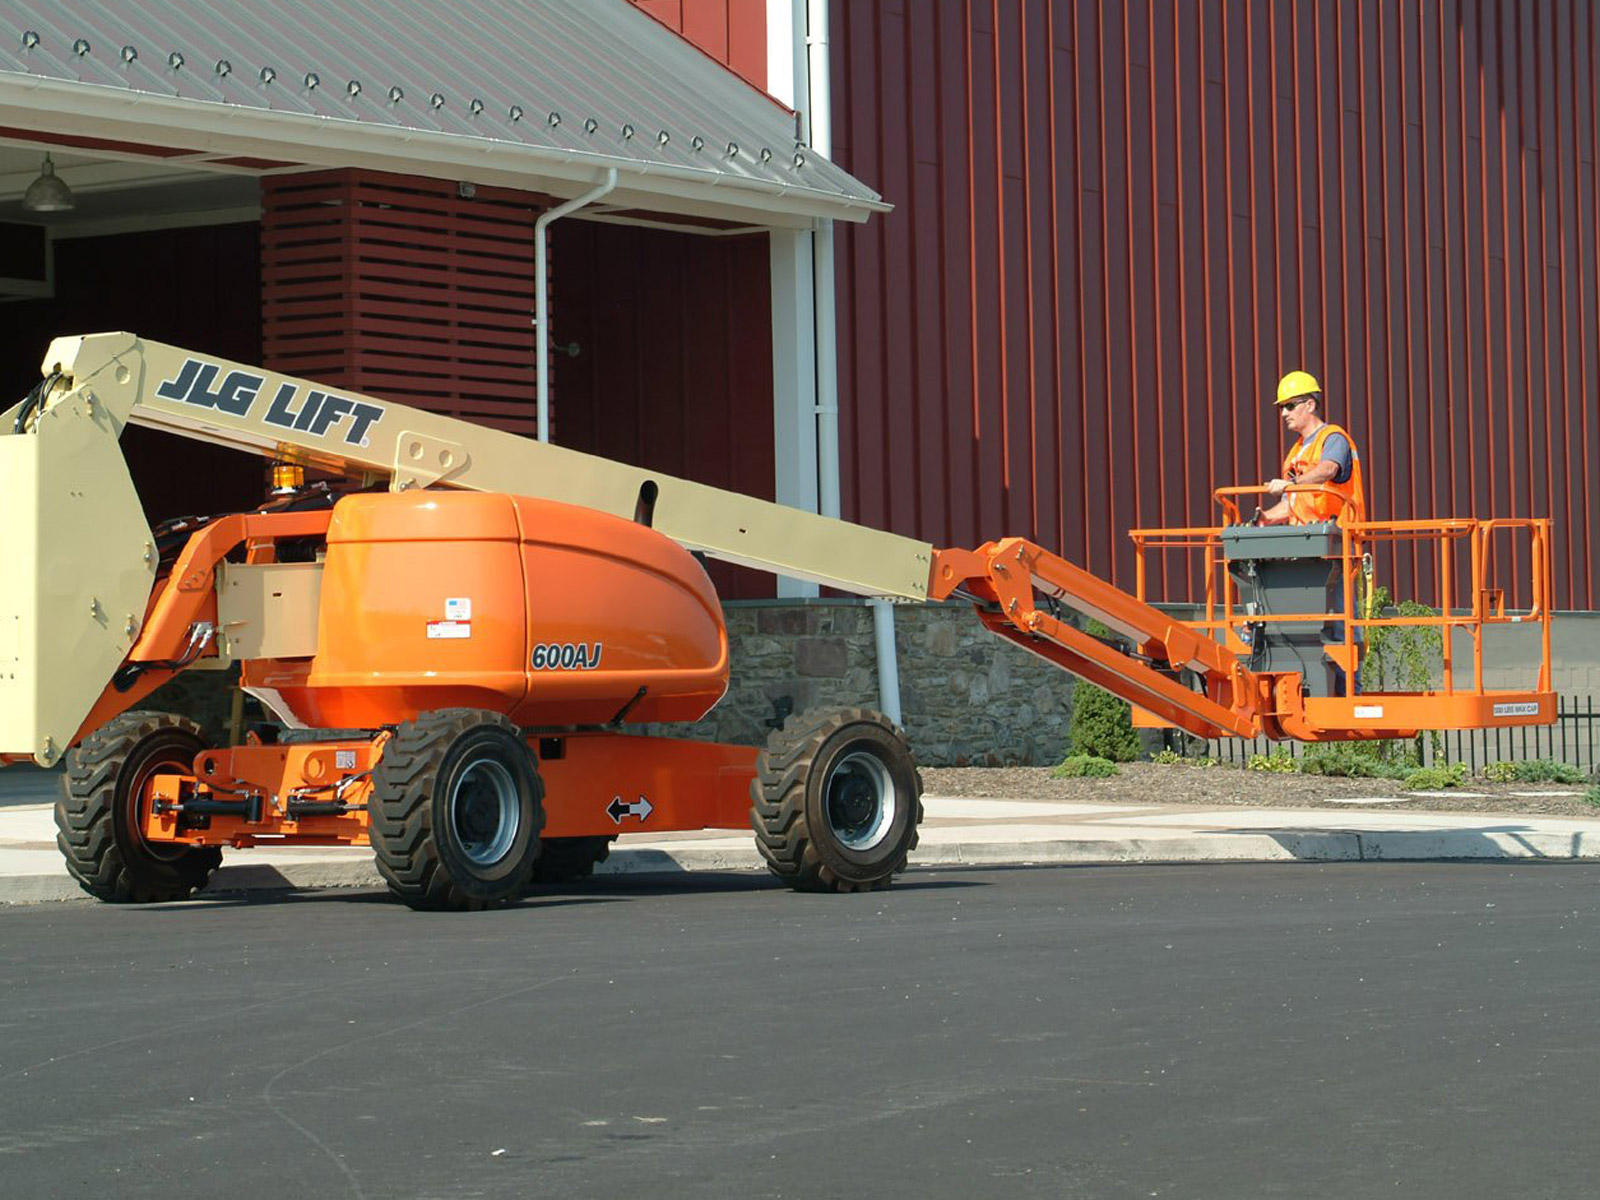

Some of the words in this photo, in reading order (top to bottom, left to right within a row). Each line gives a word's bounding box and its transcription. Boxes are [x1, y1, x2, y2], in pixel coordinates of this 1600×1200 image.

[156, 358, 265, 418] JLG
[262, 383, 385, 445] LIFT
[531, 643, 602, 670] 600AJ
